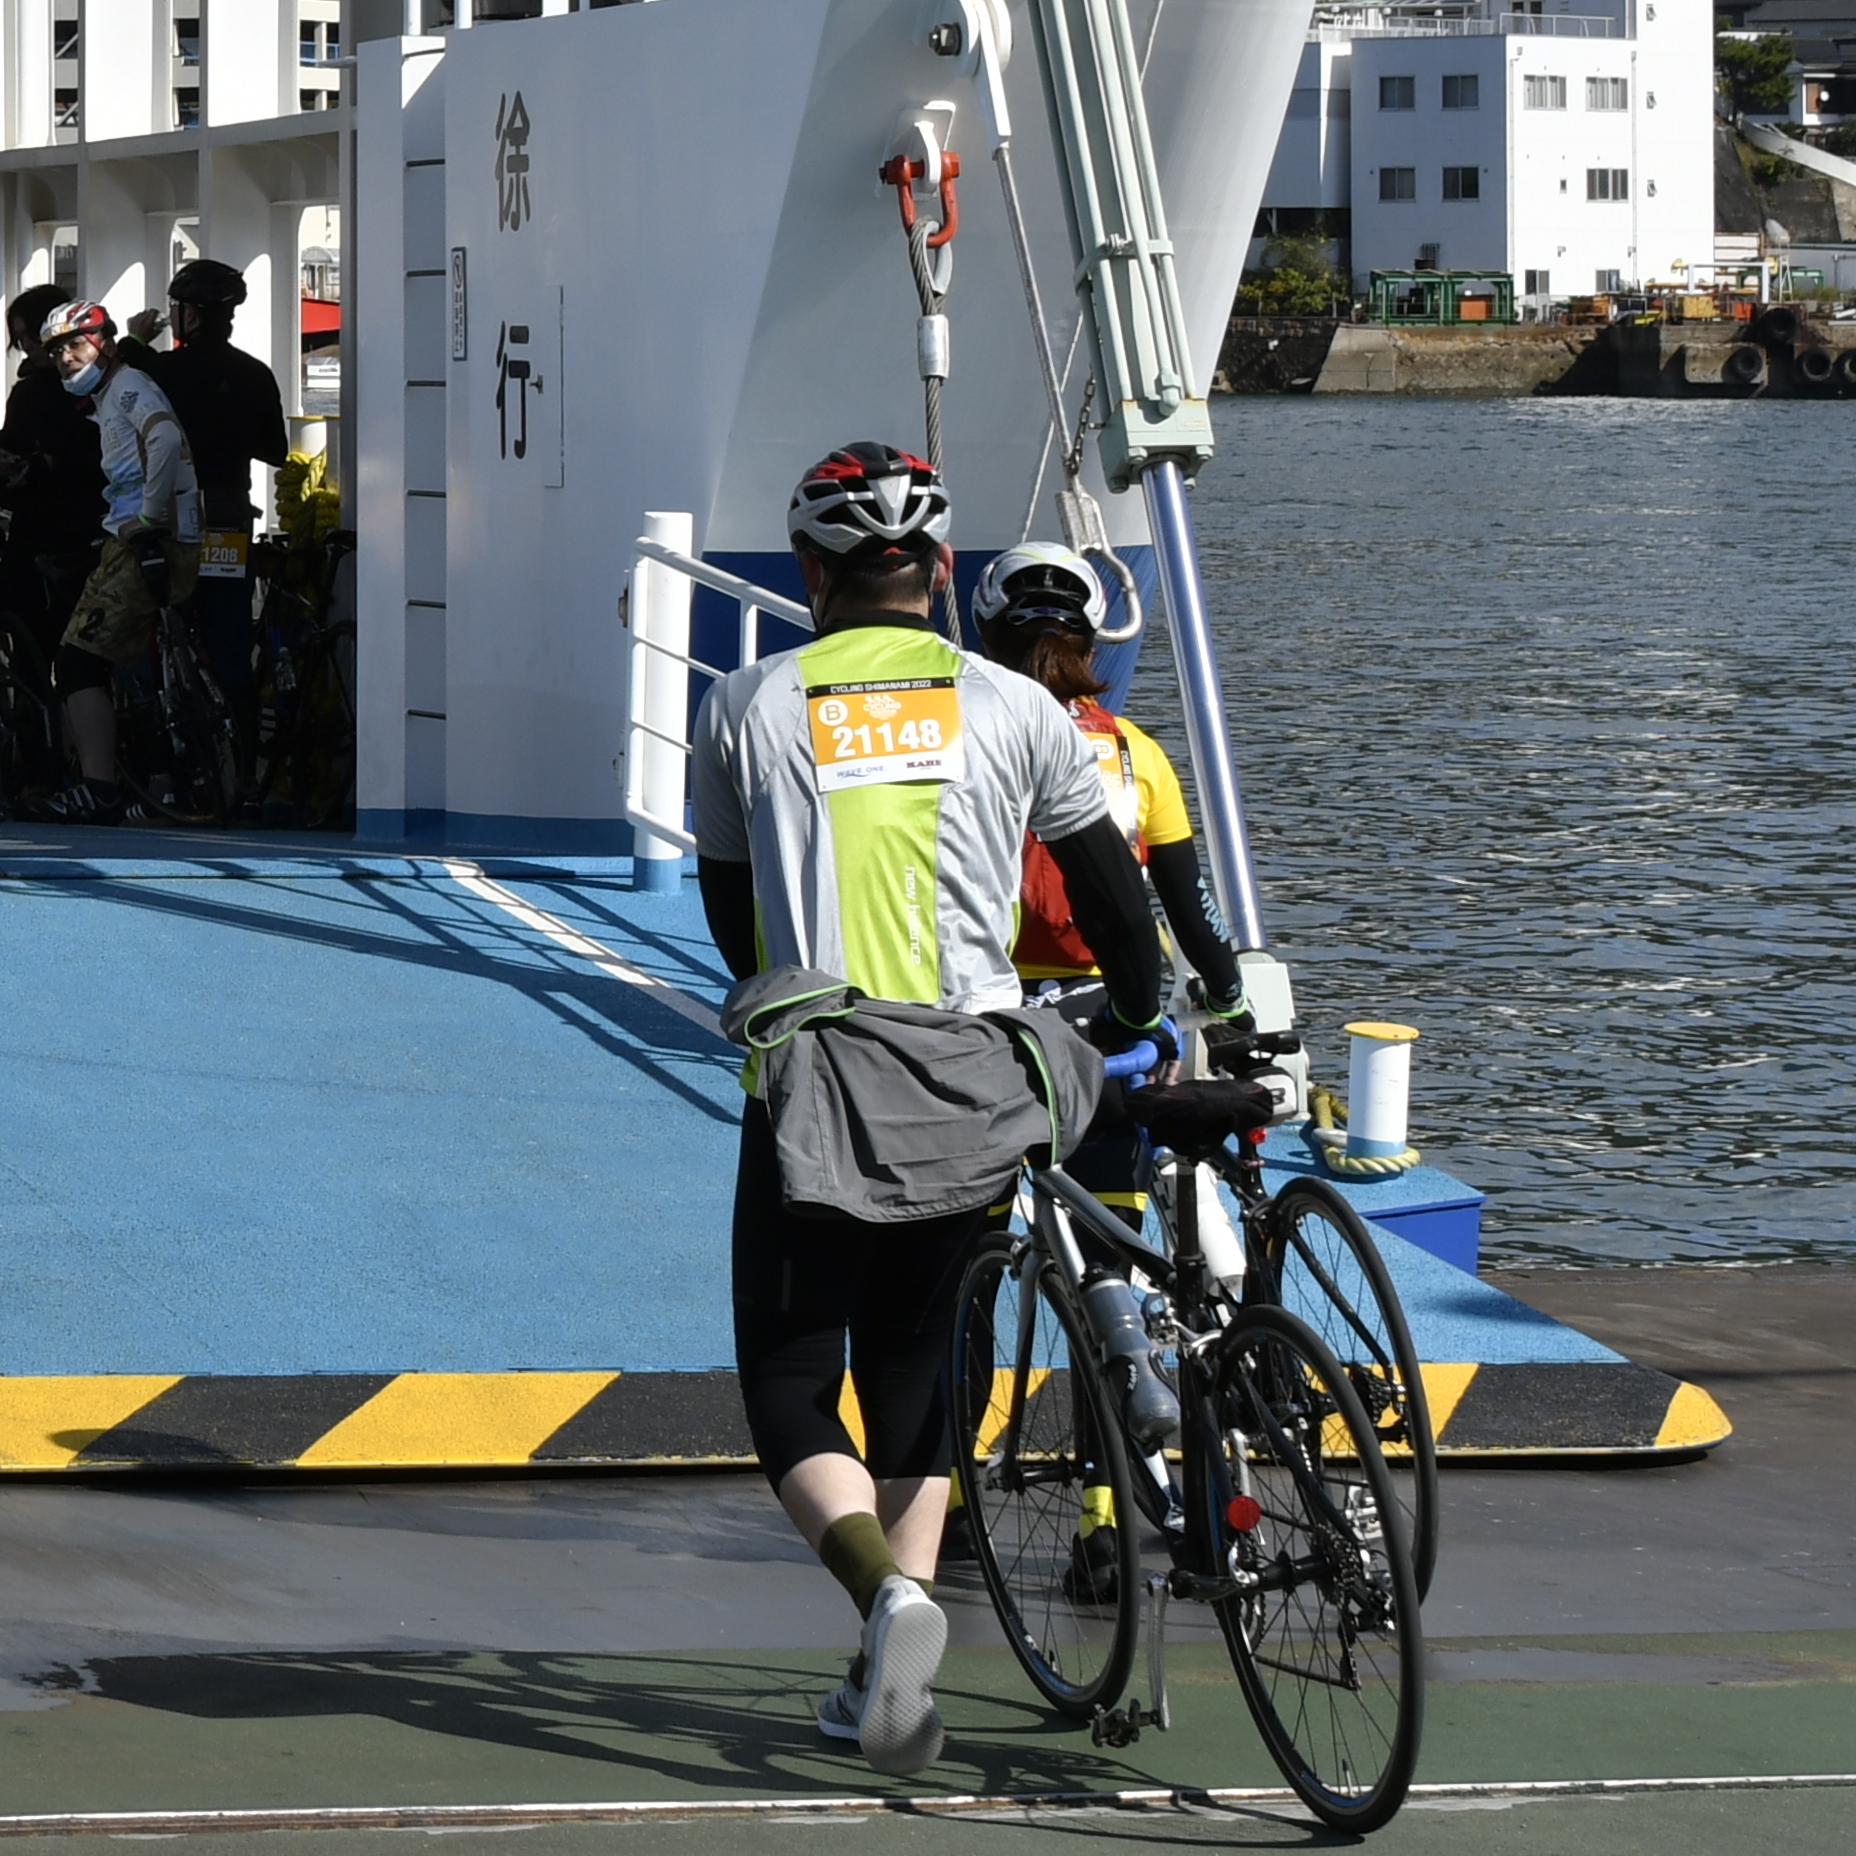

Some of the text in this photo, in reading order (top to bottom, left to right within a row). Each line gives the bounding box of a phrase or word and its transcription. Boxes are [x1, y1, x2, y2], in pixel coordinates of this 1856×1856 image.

[494, 90, 532, 460] 徐行
[200, 546, 239, 563] 1208
[829, 683, 864, 694] CYCLING
[825, 704, 841, 721] B
[832, 718, 943, 759] 21148
[836, 765, 885, 778] WAVE ONE
[905, 865, 916, 901] new
